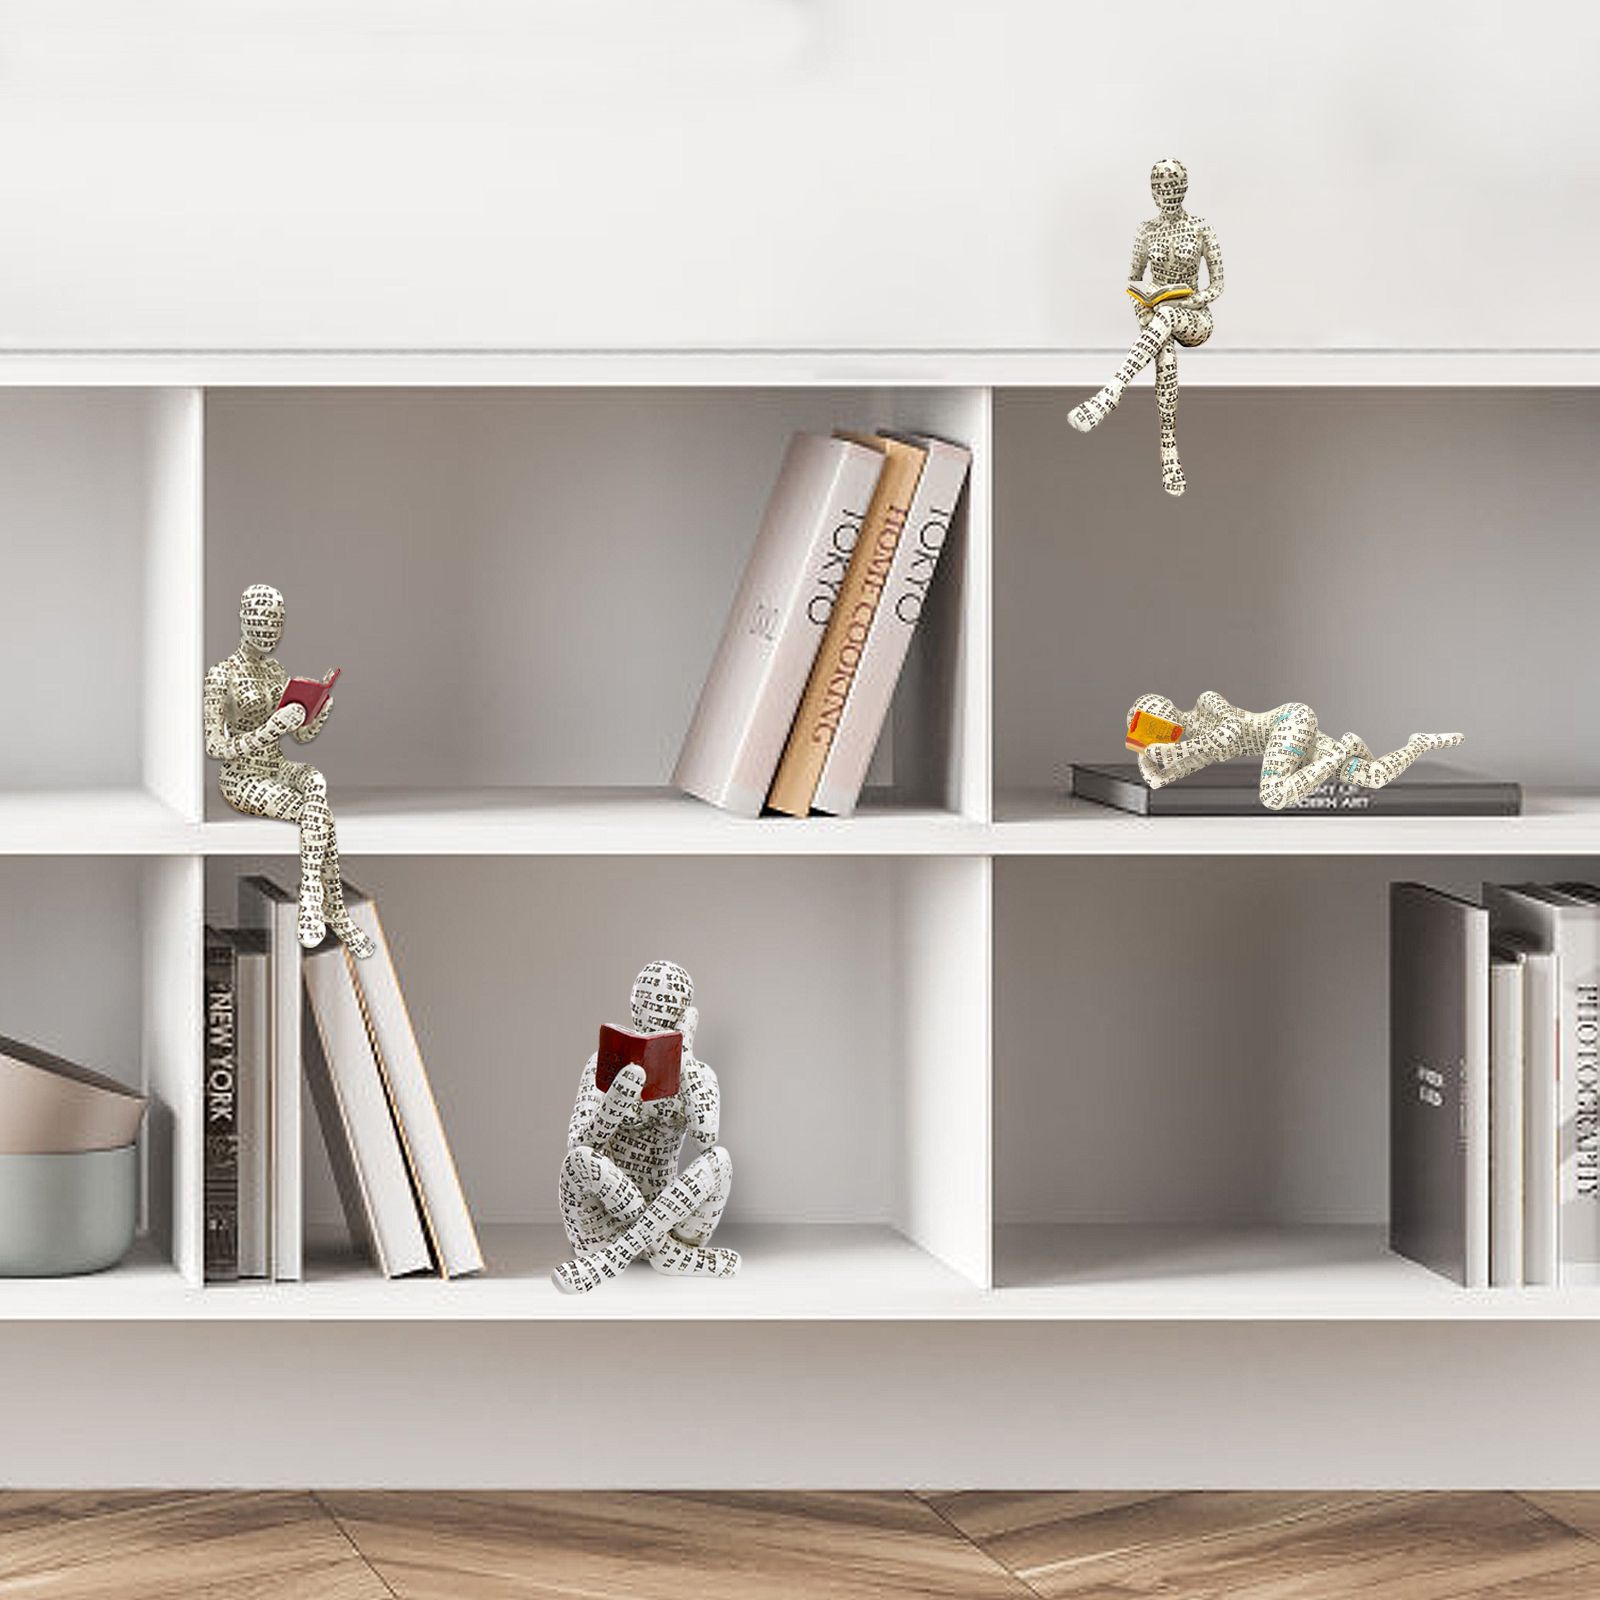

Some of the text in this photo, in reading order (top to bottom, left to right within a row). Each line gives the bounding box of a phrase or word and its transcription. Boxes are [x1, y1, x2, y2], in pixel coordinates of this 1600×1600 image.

[811, 504, 908, 743] HOME COOKING
[895, 506, 949, 625] TOKYO
[209, 991, 234, 1047] NEW
[209, 1053, 234, 1122] YORK
[1577, 984, 1600, 1199] PHOTOGRAPHY
